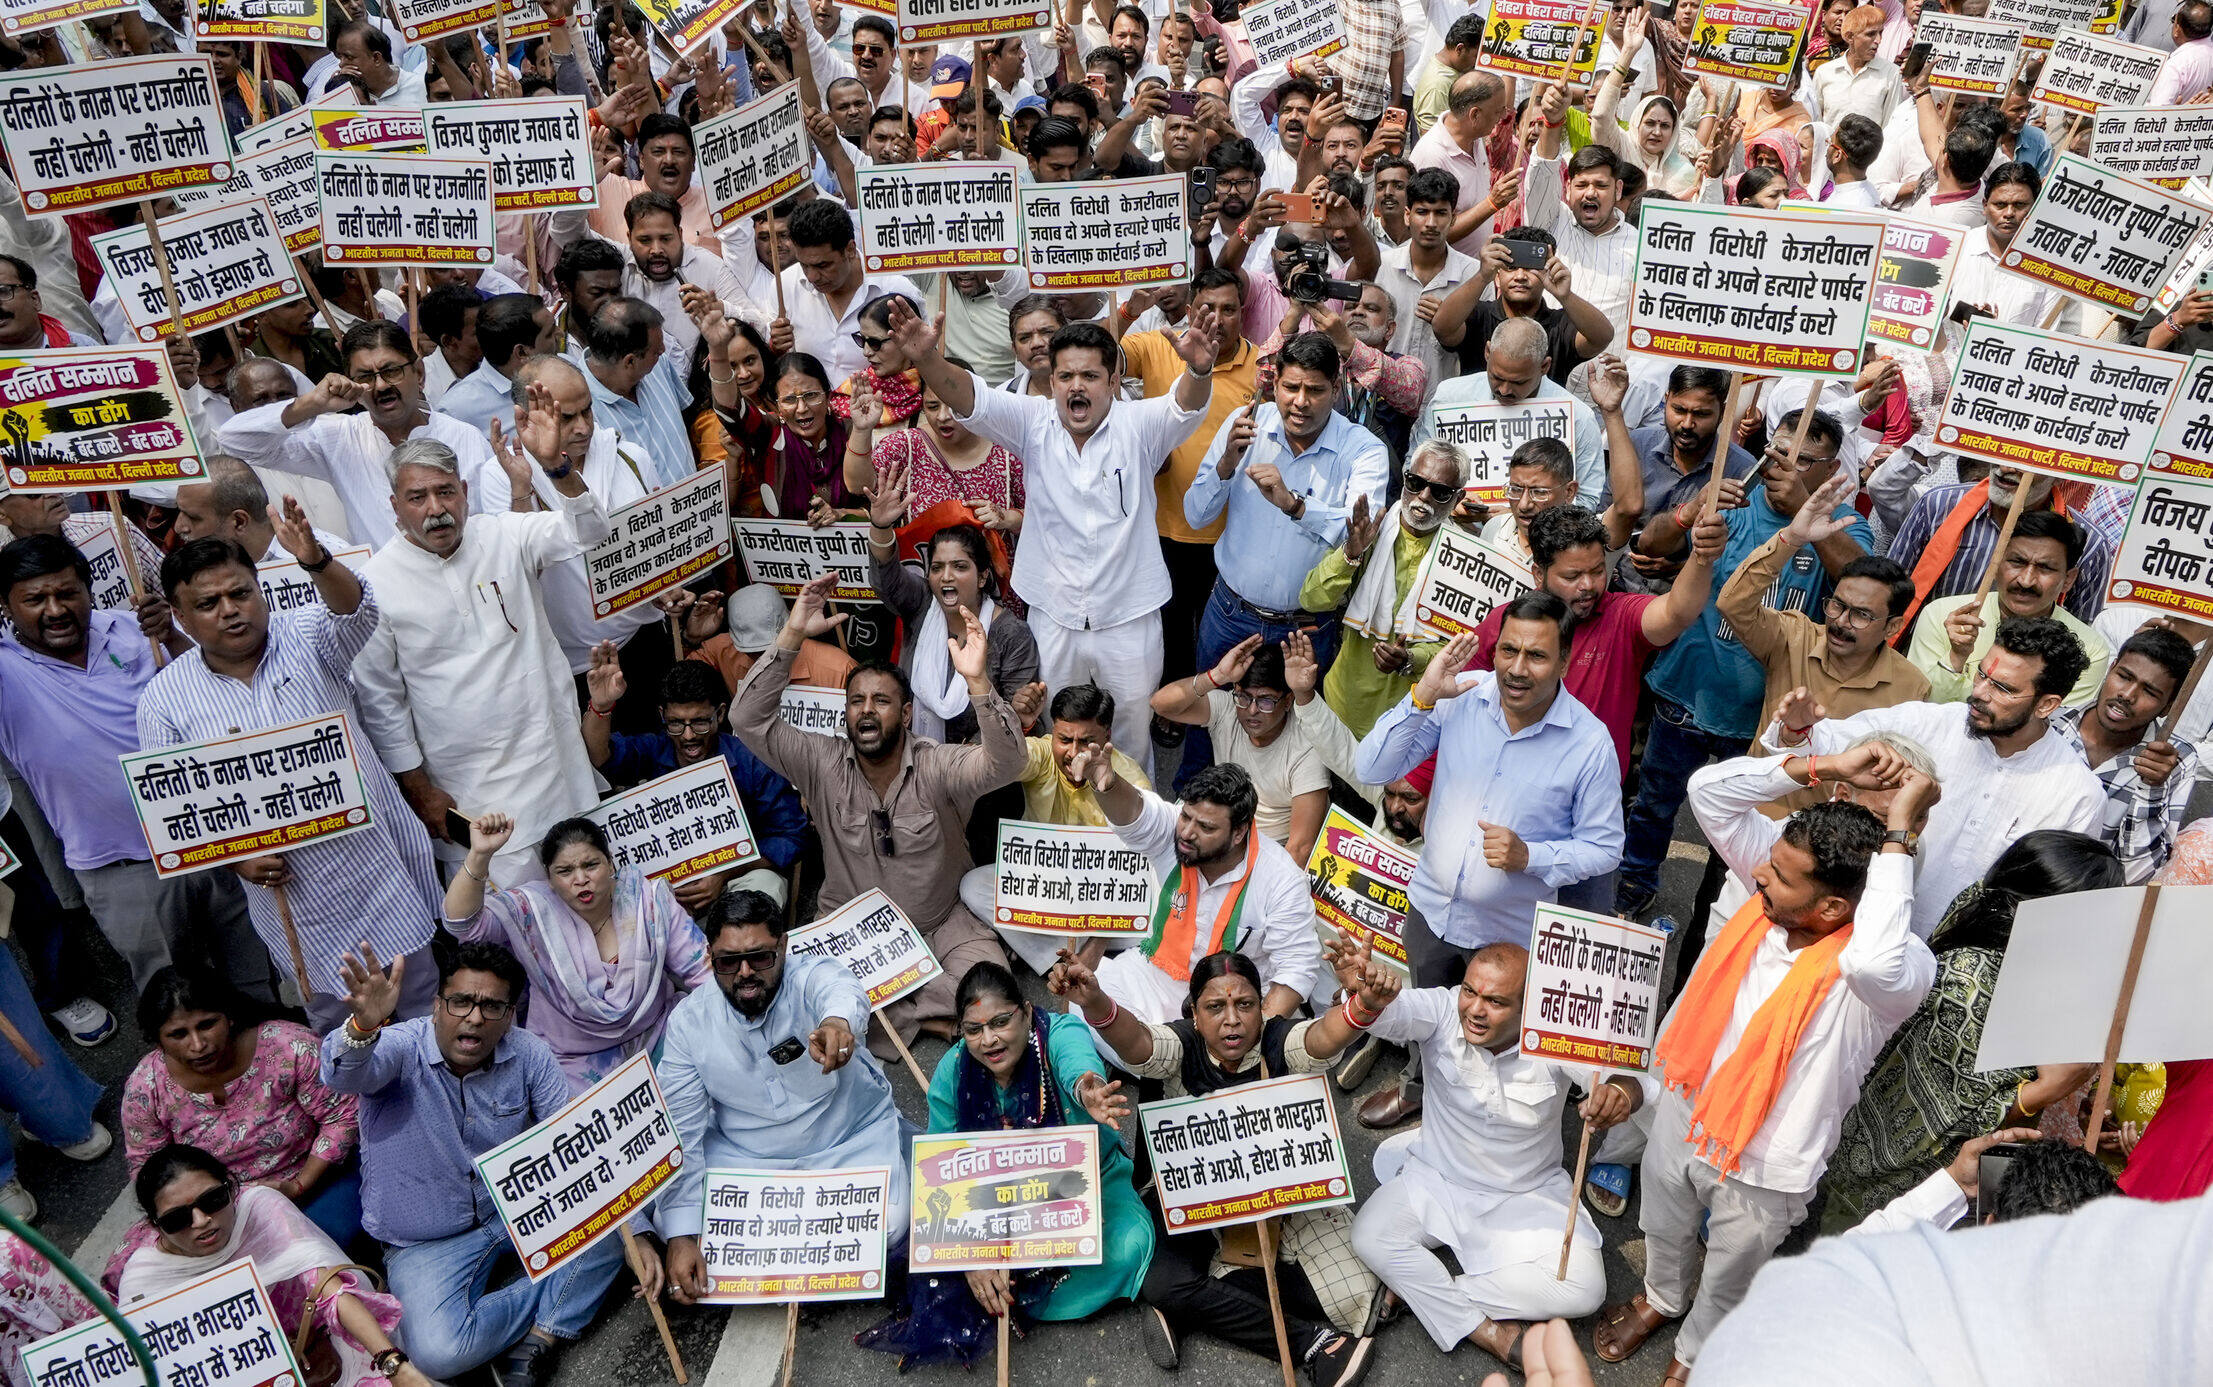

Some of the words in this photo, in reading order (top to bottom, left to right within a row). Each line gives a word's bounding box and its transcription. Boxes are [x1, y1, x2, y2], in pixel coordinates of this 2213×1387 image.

[209, 22, 232, 34] भारतीय
[232, 24, 251, 33] जनता
[250, 24, 266, 35] पार्टी,
[265, 24, 289, 35] दिल्ली
[287, 25, 308, 37] प्रदेश
[917, 24, 948, 38] भारतीय
[947, 23, 972, 35] जनता
[971, 19, 991, 33] पार्टी,
[990, 16, 1015, 31] दिल्ली
[1015, 15, 1034, 28] प्रदेश
[1253, 31, 1275, 49] जवाब
[1274, 25, 1285, 40] दो
[1284, 17, 1304, 37] अपने
[1302, 8, 1323, 28] हत्यारे
[1321, 2, 1338, 19] पार्षद
[1703, 4, 1731, 21] दोहरा
[1731, 6, 1757, 24] चेहरा
[1756, 10, 1778, 26] नहीं
[1776, 13, 1804, 29] चलेगा
[1728, 27, 1758, 45] दलितों
[1754, 33, 1768, 46] का
[1766, 31, 1793, 48] शोषण
[1735, 45, 1756, 62] नहीं
[1755, 47, 1783, 64] चलेगा
[2054, 36, 2087, 62] दलितों
[2079, 41, 2094, 64] के
[2089, 49, 2113, 69] नाम
[2109, 54, 2126, 73] पर
[2121, 56, 2162, 81] राजनीति
[0, 84, 58, 131] दलितों
[53, 82, 77, 124] के
[73, 86, 117, 121] नाम
[112, 82, 142, 115] पर
[138, 66, 211, 112] राजनीति
[431, 115, 475, 150] विजय
[475, 118, 522, 156] कुमार
[521, 116, 562, 143] जवाब
[562, 107, 580, 140] दो
[698, 127, 729, 168] दलितों
[727, 124, 739, 155] के
[737, 120, 759, 150] नाम
[757, 114, 771, 141] पर
[768, 91, 800, 136] राजनीति
[492, 153, 512, 186] को
[512, 152, 557, 188] इंसाफ़
[558, 148, 575, 181] दो
[861, 176, 900, 210] दलितों
[900, 175, 914, 208] के
[914, 181, 942, 206] नाम
[943, 180, 961, 205] पर
[962, 171, 1013, 204] राजनीति
[1025, 197, 1061, 218] दलित
[1069, 194, 1110, 216] विरोधी
[1119, 190, 1181, 213] केजरीवाल
[2047, 166, 2133, 227] केजरीवाल
[2119, 203, 2170, 241] चुप्पी
[2157, 210, 2201, 255] तोड़ो
[345, 246, 379, 259] भारतीय
[378, 248, 405, 258] जनता
[404, 247, 426, 260] पार्टी,
[426, 247, 454, 260] दिल्ली
[453, 247, 475, 260] प्रदेश
[1030, 245, 1044, 265] के
[1045, 245, 1094, 265] खिलाफ़
[1095, 239, 1141, 262] कार्रवाई
[1142, 237, 1168, 258] करो
[1646, 221, 1696, 253] दलित
[1709, 226, 1769, 260] विरोधी
[1781, 232, 1874, 267] केजरीवाल
[2026, 218, 2079, 258] जवाब
[2070, 229, 2098, 265] दो
[2099, 246, 2151, 283] जवाब
[2141, 255, 2168, 289] दो
[2020, 258, 2052, 278] भारतीय
[2051, 269, 2078, 287] जनता
[2074, 278, 2096, 295] पार्टी,
[2092, 283, 2120, 302] दिल्ली
[2115, 291, 2137, 307] प्रदेश
[1652, 335, 1698, 354] भारतीय
[1698, 341, 1734, 358] जनता
[1733, 343, 1761, 364] पार्टी,
[1763, 345, 1801, 365] दिल्ली
[1799, 348, 1832, 367] प्रदेश
[0, 366, 58, 403] दलित
[54, 361, 140, 389] सम्मान
[69, 406, 97, 427] का
[96, 400, 132, 424] ढोंग
[1950, 392, 1970, 417] के
[1969, 397, 2034, 432] खिलाफ़
[2033, 415, 2097, 446] कार्रवाई
[2094, 426, 2131, 451] करो
[590, 548, 623, 574] जवाब
[622, 540, 637, 559] दो
[638, 526, 666, 553] अपने
[666, 511, 698, 540] हत्यारे
[698, 500, 724, 523] पार्षद
[739, 526, 814, 554] केजरीवाल
[813, 530, 848, 561] चुप्पी
[612, 588, 641, 609] भारतीय
[640, 578, 663, 596] जनता
[662, 568, 680, 584] पार्टी,
[679, 558, 701, 577] दिल्ली
[700, 550, 717, 566] प्रदेश
[1438, 536, 1515, 598] केजरीवाल
[133, 758, 192, 802] दलितों
[188, 756, 211, 791] के
[208, 754, 252, 786] नाम
[248, 749, 278, 778] पर
[274, 724, 347, 773] राजनीति
[1000, 870, 1026, 897] होश
[1027, 873, 1042, 899] में
[1041, 875, 1075, 905] आओ,
[1077, 876, 1103, 903] होश
[1103, 877, 1119, 903] में
[1118, 878, 1149, 904] आओ
[495, 1152, 557, 1202] दलित
[551, 1108, 612, 1172] विरोधी
[608, 1078, 656, 1131] आपदा
[1149, 1119, 1189, 1154] दलित
[1186, 1108, 1232, 1149] विरोधी
[1229, 1104, 1274, 1140] सौरभ
[1273, 1098, 1328, 1132] भारद्वाज
[511, 1191, 557, 1237] वालों
[552, 1170, 598, 1213] जवाब
[593, 1155, 615, 1184] दो
[619, 1123, 657, 1165] जवाब
[651, 1109, 670, 1137] दो
[937, 1144, 992, 1181] दलित
[993, 1141, 1067, 1168] सम्मान
[548, 1227, 586, 1260] भारतीय
[583, 1209, 611, 1235] जनता
[608, 1193, 632, 1215] पार्टी,
[628, 1173, 655, 1202] दिल्ली
[651, 1160, 671, 1184] प्रदेश
[709, 1184, 750, 1209] दलित
[760, 1186, 805, 1209] विरोधी
[815, 1183, 882, 1208] केजरीवाल
[994, 1185, 1019, 1204] का
[1019, 1178, 1049, 1202] ढोंग
[706, 1217, 747, 1237] जवाब
[748, 1214, 764, 1237] दो
[766, 1214, 803, 1237] अपने
[804, 1211, 845, 1236] हत्यारे
[846, 1208, 880, 1233] पार्षद
[706, 1241, 720, 1267] के
[721, 1241, 778, 1268] खिलाफ़
[780, 1240, 832, 1266] कार्रवाई
[833, 1238, 862, 1263] करो
